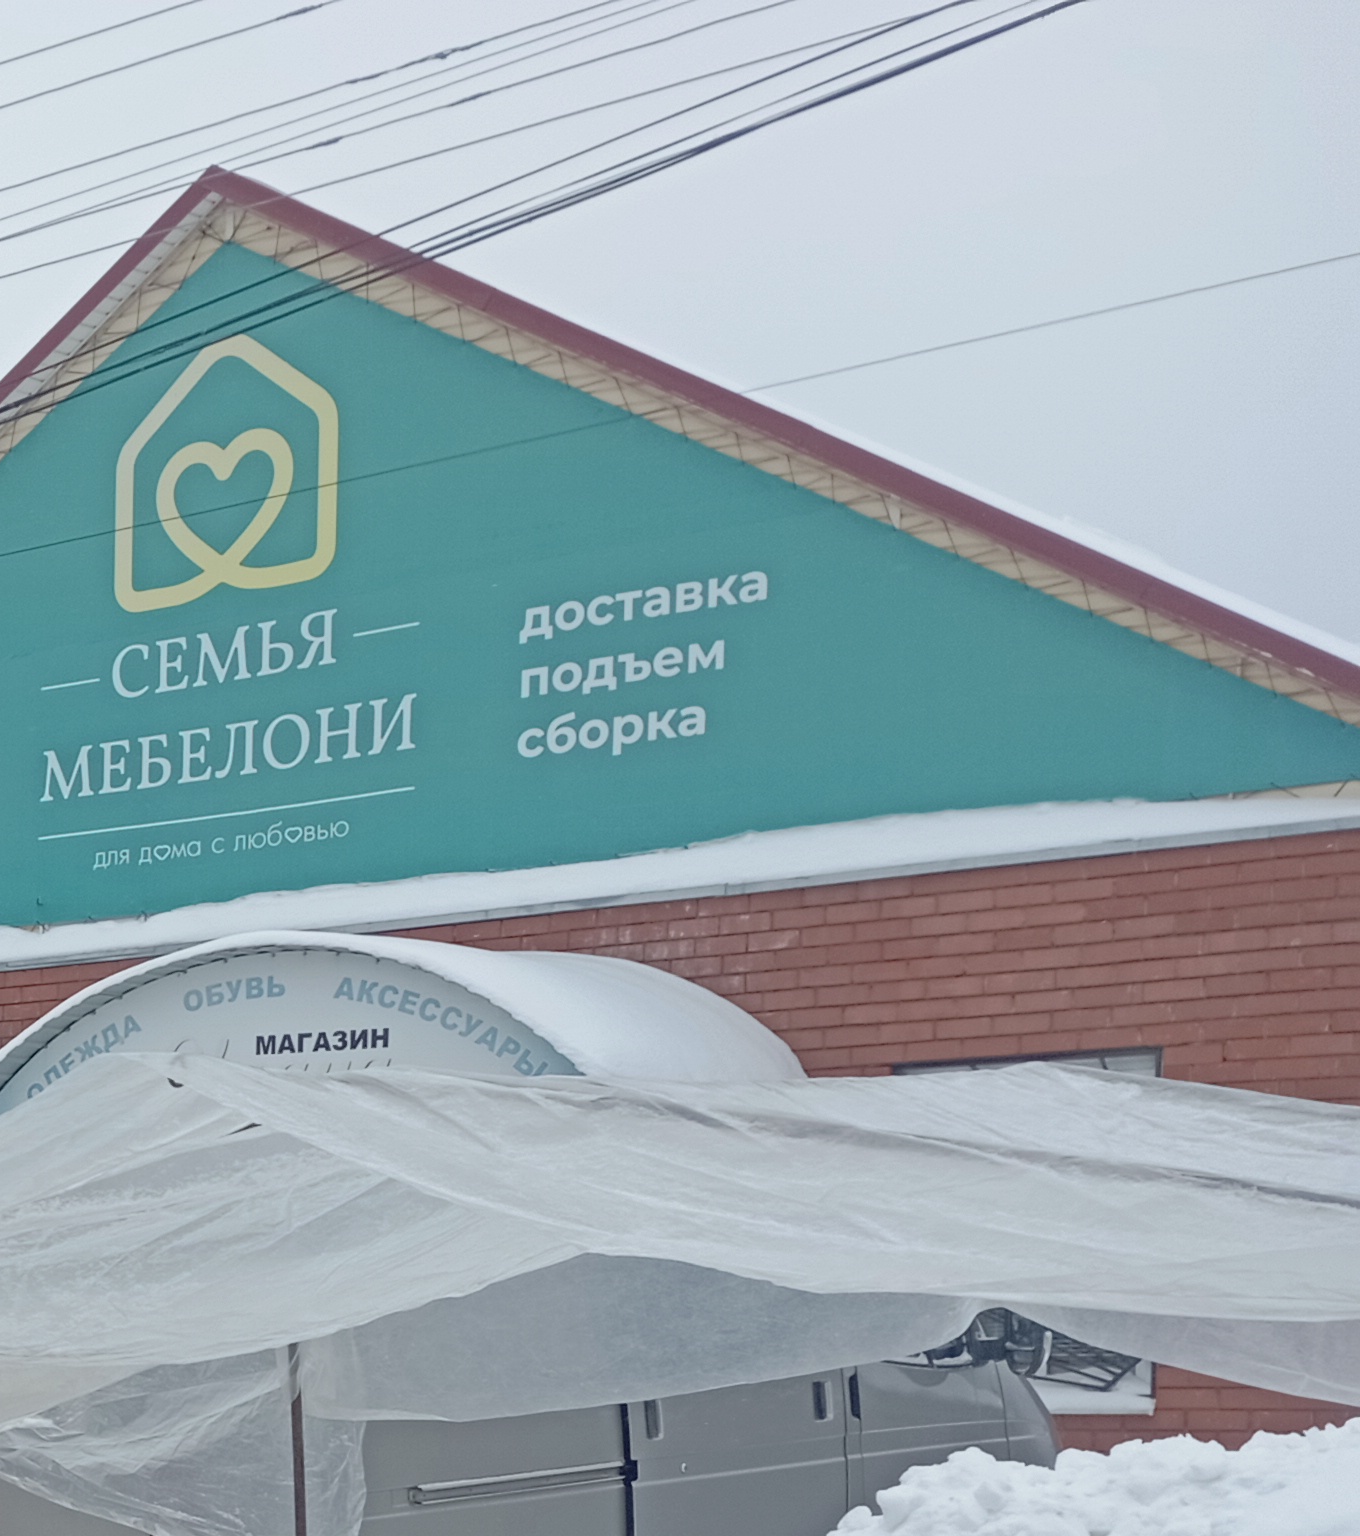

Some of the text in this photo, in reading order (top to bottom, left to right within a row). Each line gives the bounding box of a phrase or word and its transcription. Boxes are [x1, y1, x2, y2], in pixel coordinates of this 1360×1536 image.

[518, 570, 769, 645] доставка
[111, 608, 338, 699] СЕМЬЯ
[520, 639, 726, 699] подъем
[39, 692, 418, 803] МЕБЕЛОНИ
[516, 705, 707, 758] сборка
[92, 846, 131, 871] для
[210, 838, 225, 854] с
[182, 974, 287, 1013] ОБУВЬ
[255, 1028, 390, 1055] МАГАЗИН
[333, 976, 550, 1077] АКСЕССУАРЫ
